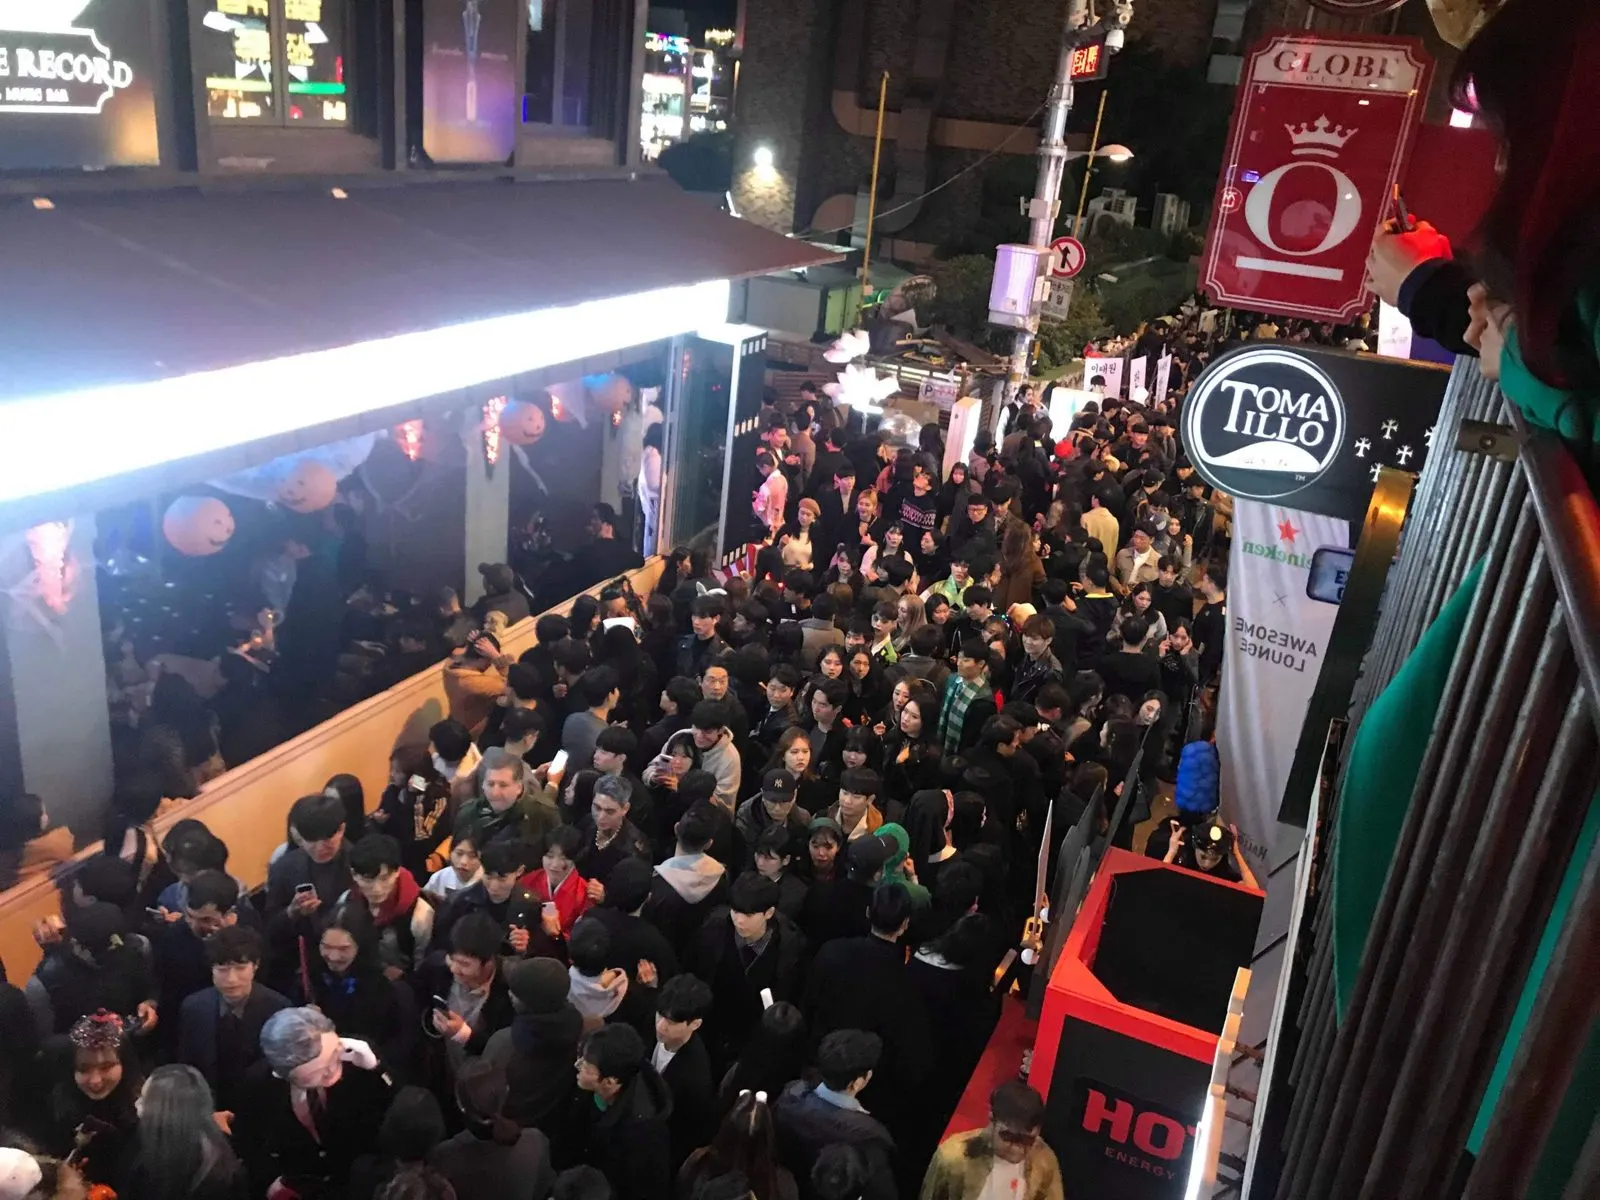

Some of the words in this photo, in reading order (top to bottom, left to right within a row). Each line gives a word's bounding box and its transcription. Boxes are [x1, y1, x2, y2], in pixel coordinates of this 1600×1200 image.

[16, 48, 133, 88] RECORD
[1091, 362, 1117, 374] 이태원
[1220, 379, 1329, 431] TOMA
[1082, 1088, 1196, 1160] HO
[1104, 1146, 1175, 1180] ENERGY
